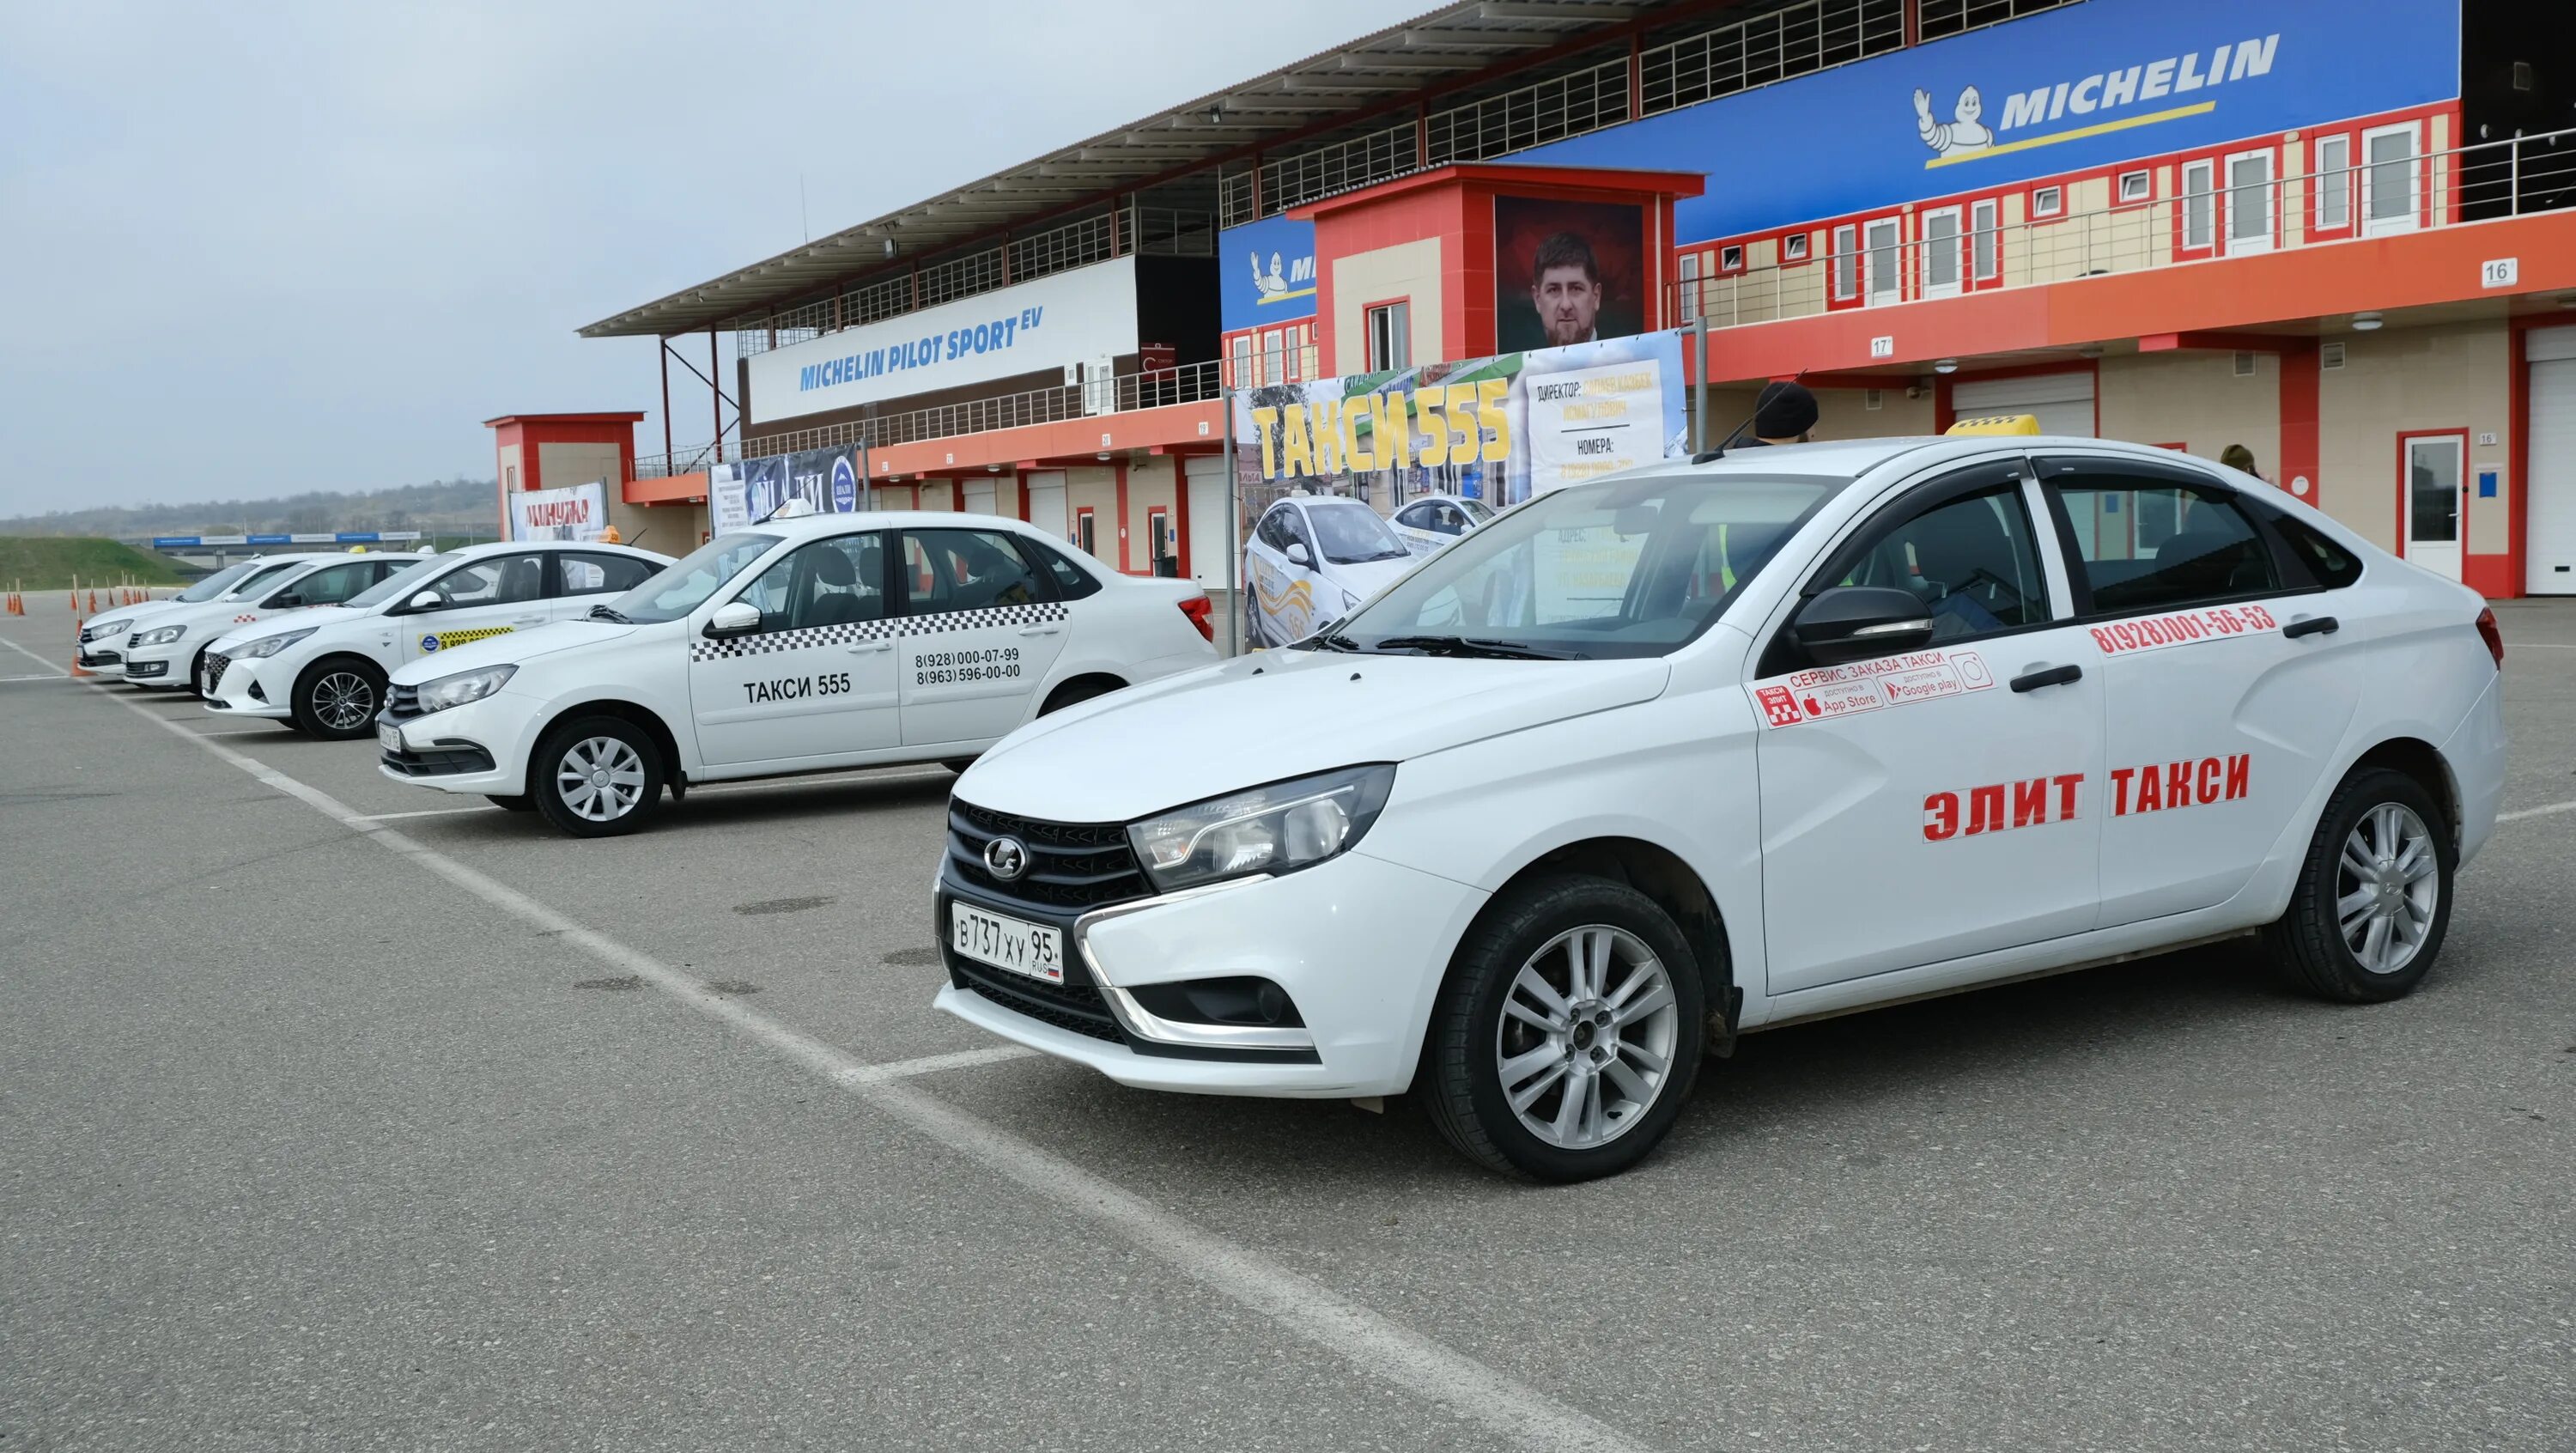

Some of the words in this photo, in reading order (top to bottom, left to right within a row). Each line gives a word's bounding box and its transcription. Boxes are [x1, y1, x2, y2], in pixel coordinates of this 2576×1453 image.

[1999, 33, 2281, 131] MICHELIN
[2486, 262, 2508, 281] 16
[799, 348, 885, 392] MICHELIN
[888, 335, 943, 373] PILOT
[946, 317, 1018, 361] SPORT
[1020, 306, 1043, 331] EV
[1874, 339, 1887, 353] 17
[1537, 381, 1582, 402] ДИРЕКТОР:
[1251, 391, 1411, 479] ТАКСИ
[1413, 377, 1511, 468] 555
[1577, 437, 1614, 455] НОМЕРА:
[2090, 605, 2276, 654] 8(928)001-56-53
[915, 647, 1019, 668] 8(928)000-07-99
[1789, 668, 1847, 688] СЕРВИС
[1847, 658, 1903, 678] ЗАКАЗА
[1901, 651, 1946, 670] ТАКСИ
[1903, 672, 1935, 683] ДОСТУПНО
[744, 676, 812, 704] ТАКСИ
[817, 672, 851, 696] 555
[1759, 686, 1785, 696] ТАКСИ
[1824, 684, 1858, 697] ДОСТУПНО
[1901, 683, 1937, 697] Google
[1938, 678, 1958, 693] play
[1767, 694, 1788, 705] ЭЛИТ
[1824, 699, 1846, 712] App
[1849, 693, 1876, 708] Store
[1923, 772, 2085, 842] ЭЛИТ
[2110, 753, 2251, 817] ТАКСИ
[1031, 930, 1053, 963] 95
[1031, 960, 1048, 974] RUS
